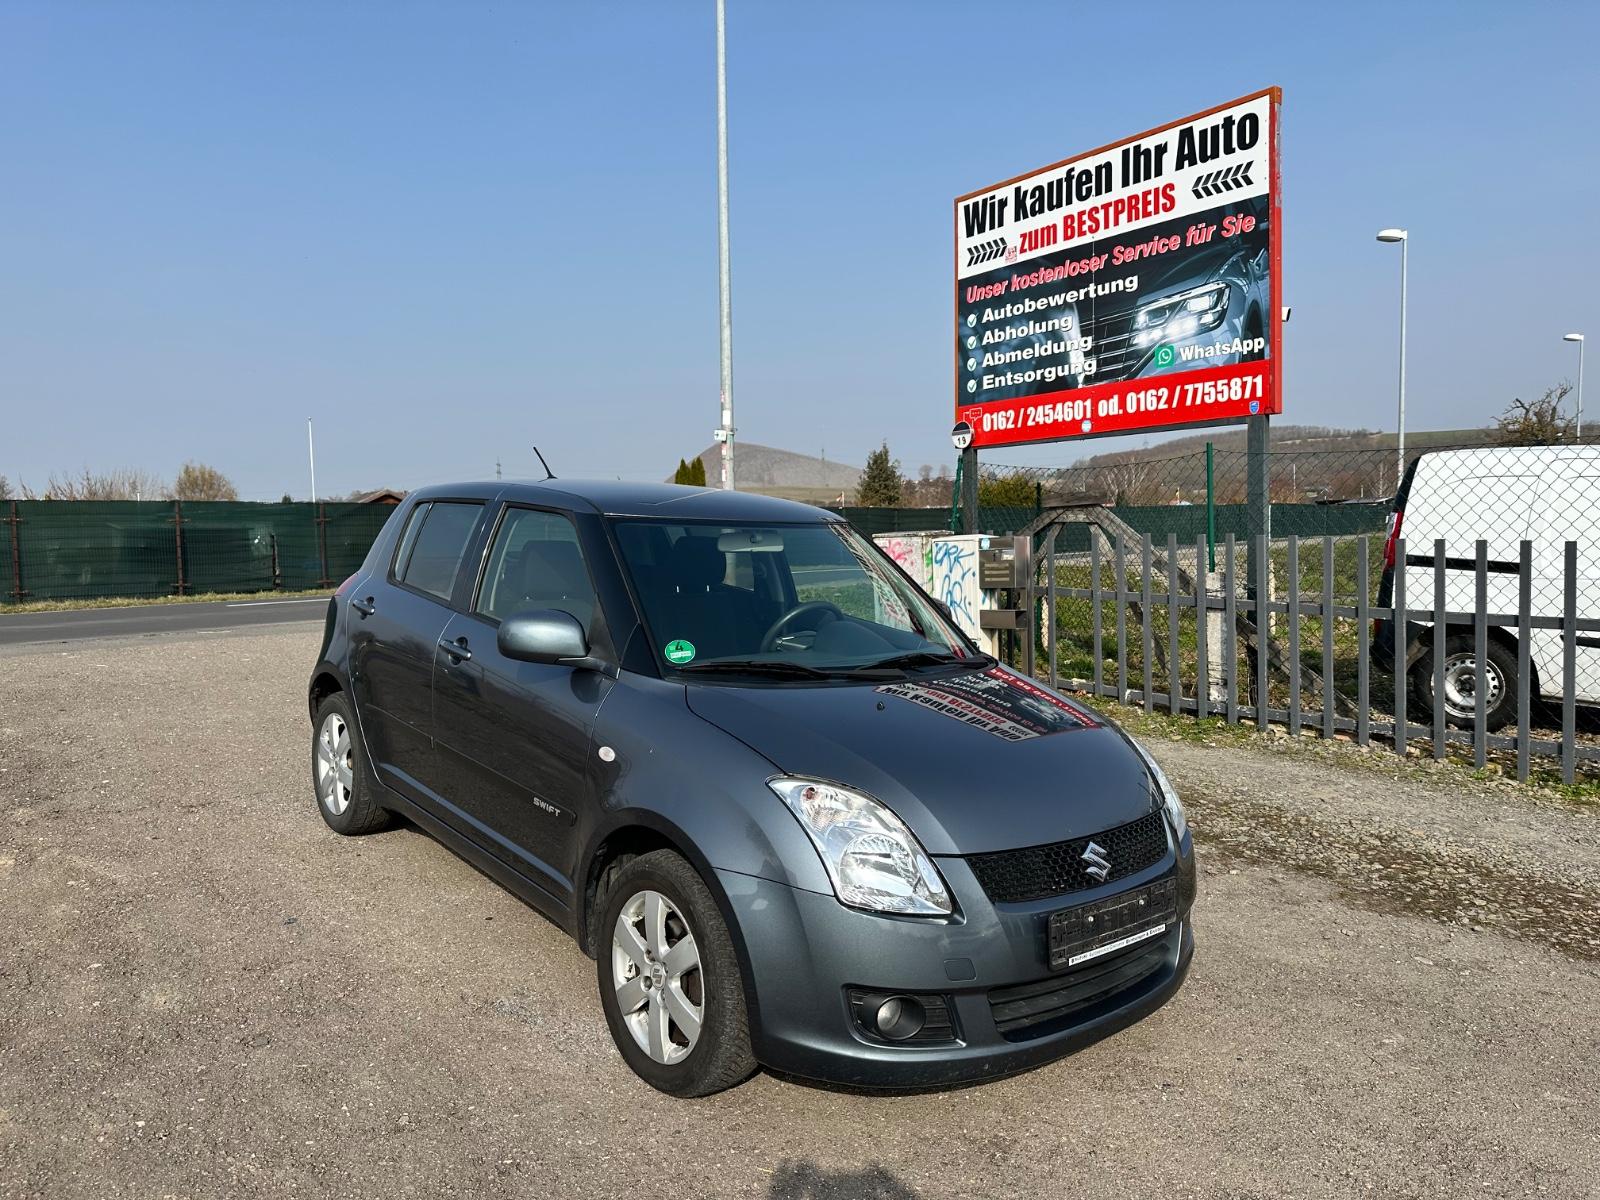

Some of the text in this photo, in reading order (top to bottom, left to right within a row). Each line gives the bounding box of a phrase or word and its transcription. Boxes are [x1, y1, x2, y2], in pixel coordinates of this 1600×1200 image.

[963, 112, 1260, 238] Wir kaufen Ihr Auto
[1019, 182, 1176, 254] zum BESTPREIS
[966, 280, 1009, 304] Unser
[1010, 252, 1108, 292] kostenloser
[1111, 234, 1181, 266] Service
[1185, 222, 1217, 247] für
[1220, 213, 1256, 238] Sie
[981, 274, 1139, 324] Autobewertung
[981, 315, 1073, 346] Abholung
[1179, 337, 1265, 361] WhatsApp
[981, 335, 1093, 368] Abmeldung
[982, 358, 1097, 390] Entsorgung
[982, 409, 1015, 432] 0162
[1026, 398, 1092, 427] 2454601
[1097, 395, 1123, 417] od.
[1126, 387, 1169, 414] 0162
[1183, 374, 1264, 407] 7755871
[533, 796, 561, 817] SWIFT
